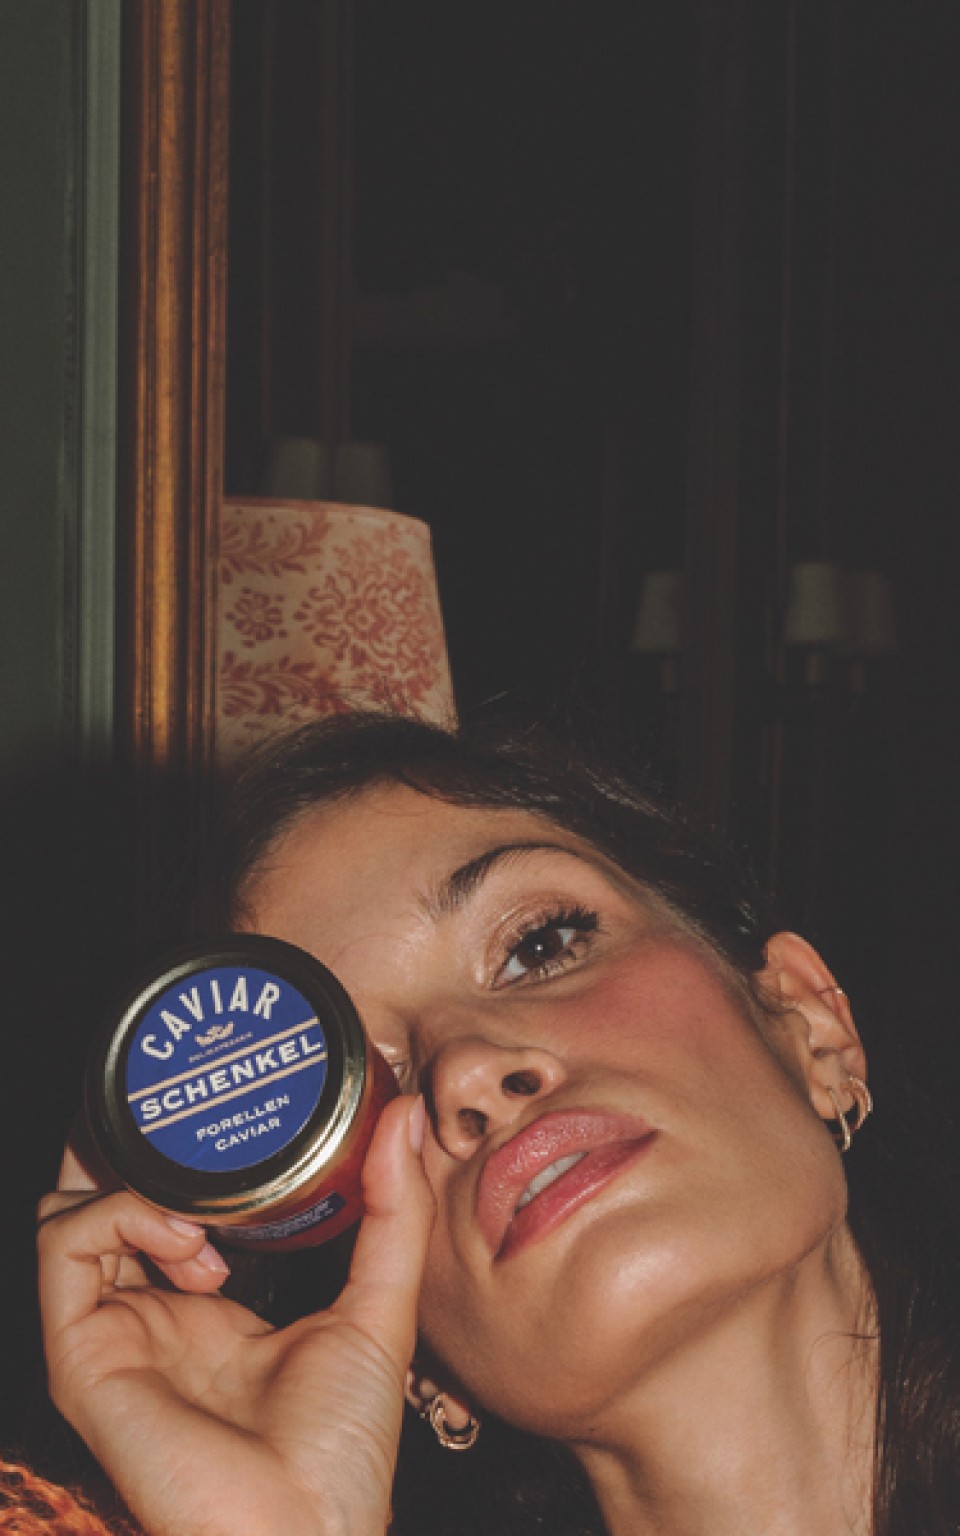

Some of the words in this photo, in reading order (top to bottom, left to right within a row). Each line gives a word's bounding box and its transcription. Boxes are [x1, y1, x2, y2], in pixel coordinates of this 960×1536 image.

[141, 975, 281, 1060] CAVIAR
[141, 1034, 323, 1120] SCHENKEL
[196, 1095, 290, 1141] FORELLEN
[215, 1118, 281, 1151] CAVIAR
